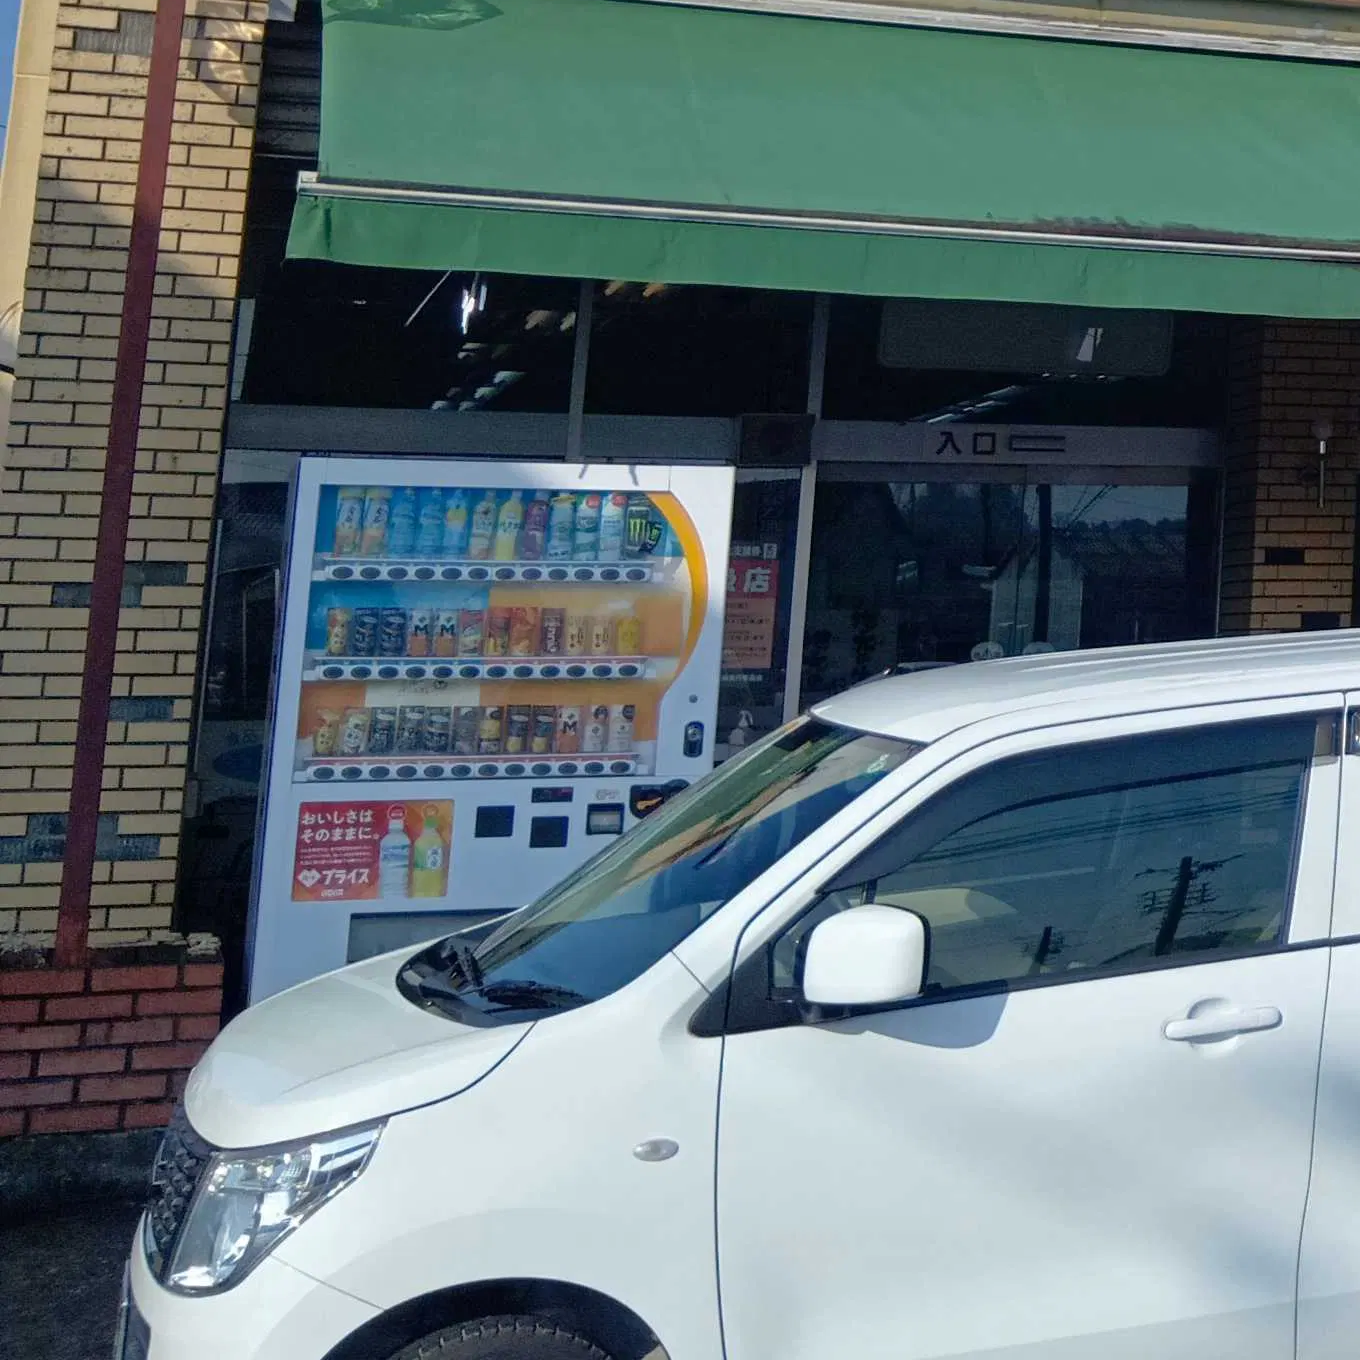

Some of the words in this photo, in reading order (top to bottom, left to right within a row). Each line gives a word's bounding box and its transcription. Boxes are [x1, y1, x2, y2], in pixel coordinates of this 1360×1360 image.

[936, 431, 996, 455] 入口
[302, 809, 374, 825] おいしさは
[301, 826, 379, 843] そのままに。
[322, 868, 370, 885] プライス
